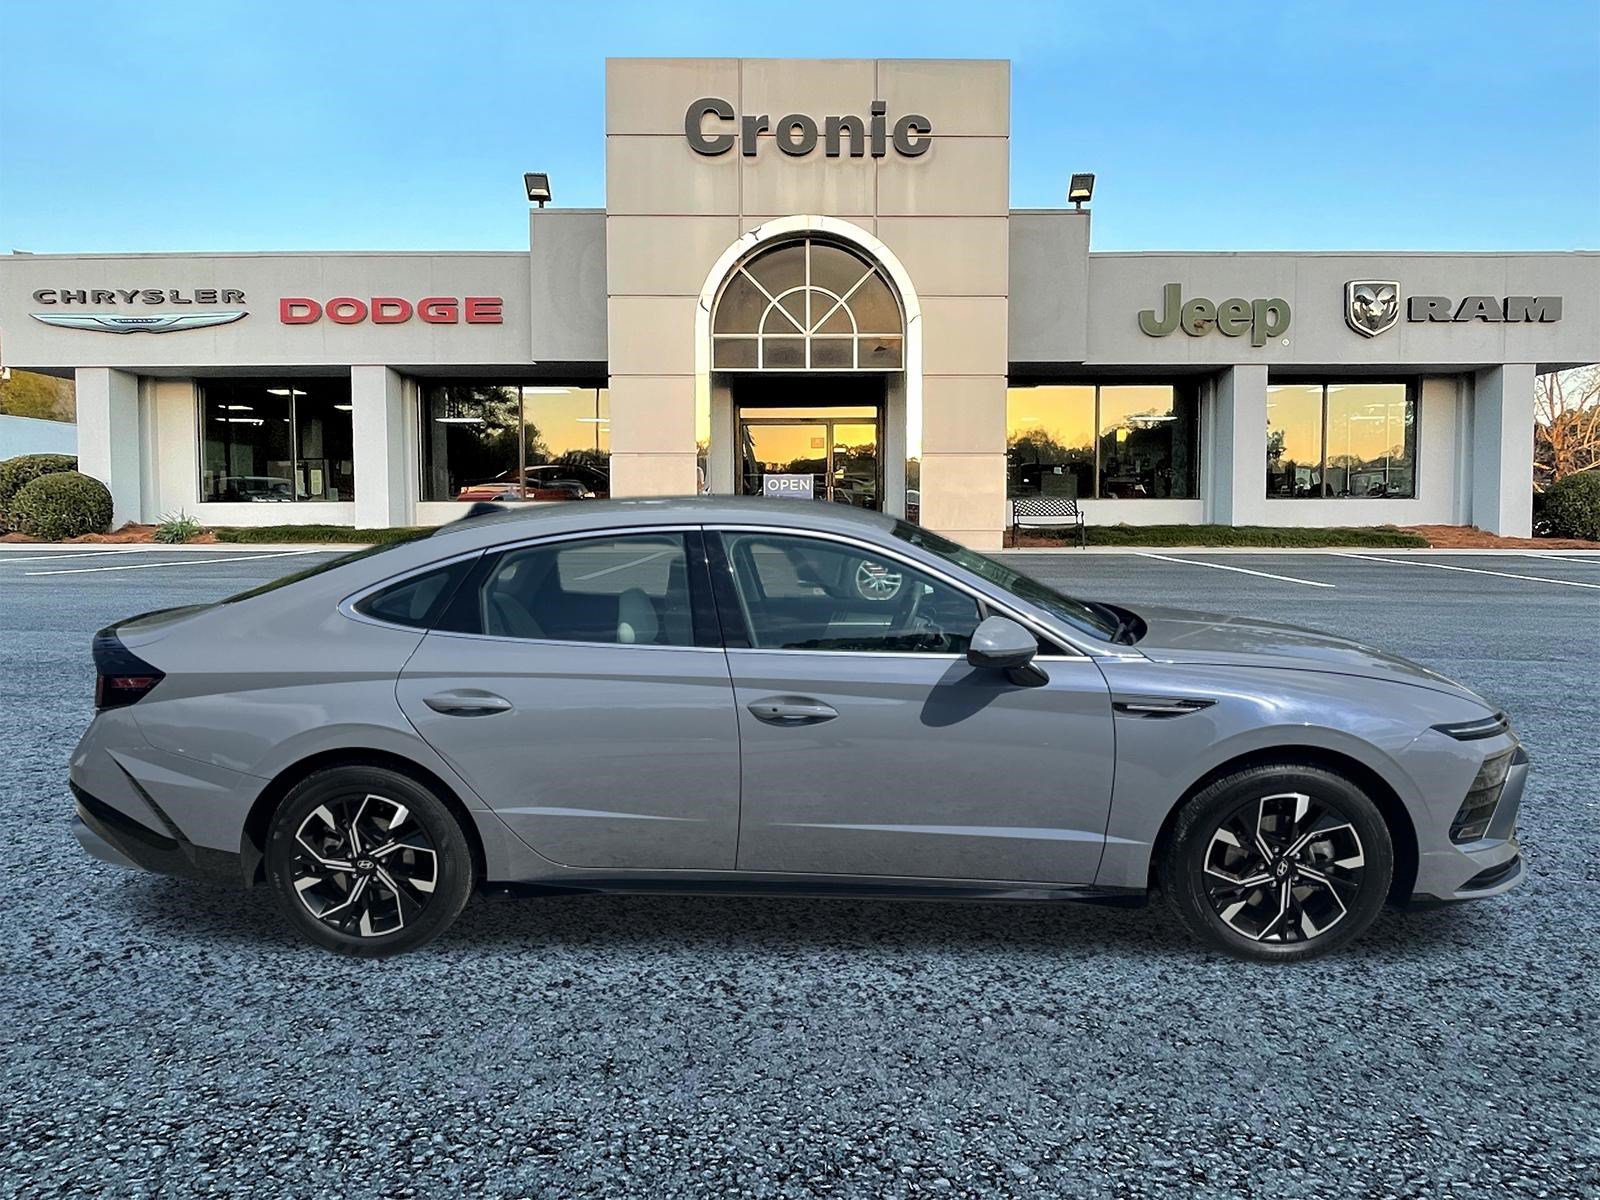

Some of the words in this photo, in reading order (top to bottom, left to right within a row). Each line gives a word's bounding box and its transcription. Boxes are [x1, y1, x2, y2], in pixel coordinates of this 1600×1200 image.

[685, 97, 932, 157] Cronic
[32, 288, 247, 305] CHRYSLER
[280, 296, 503, 325] DODGE
[1407, 295, 1563, 323] RAM
[1138, 283, 1291, 347] Jeep
[767, 479, 810, 491] OPEN
